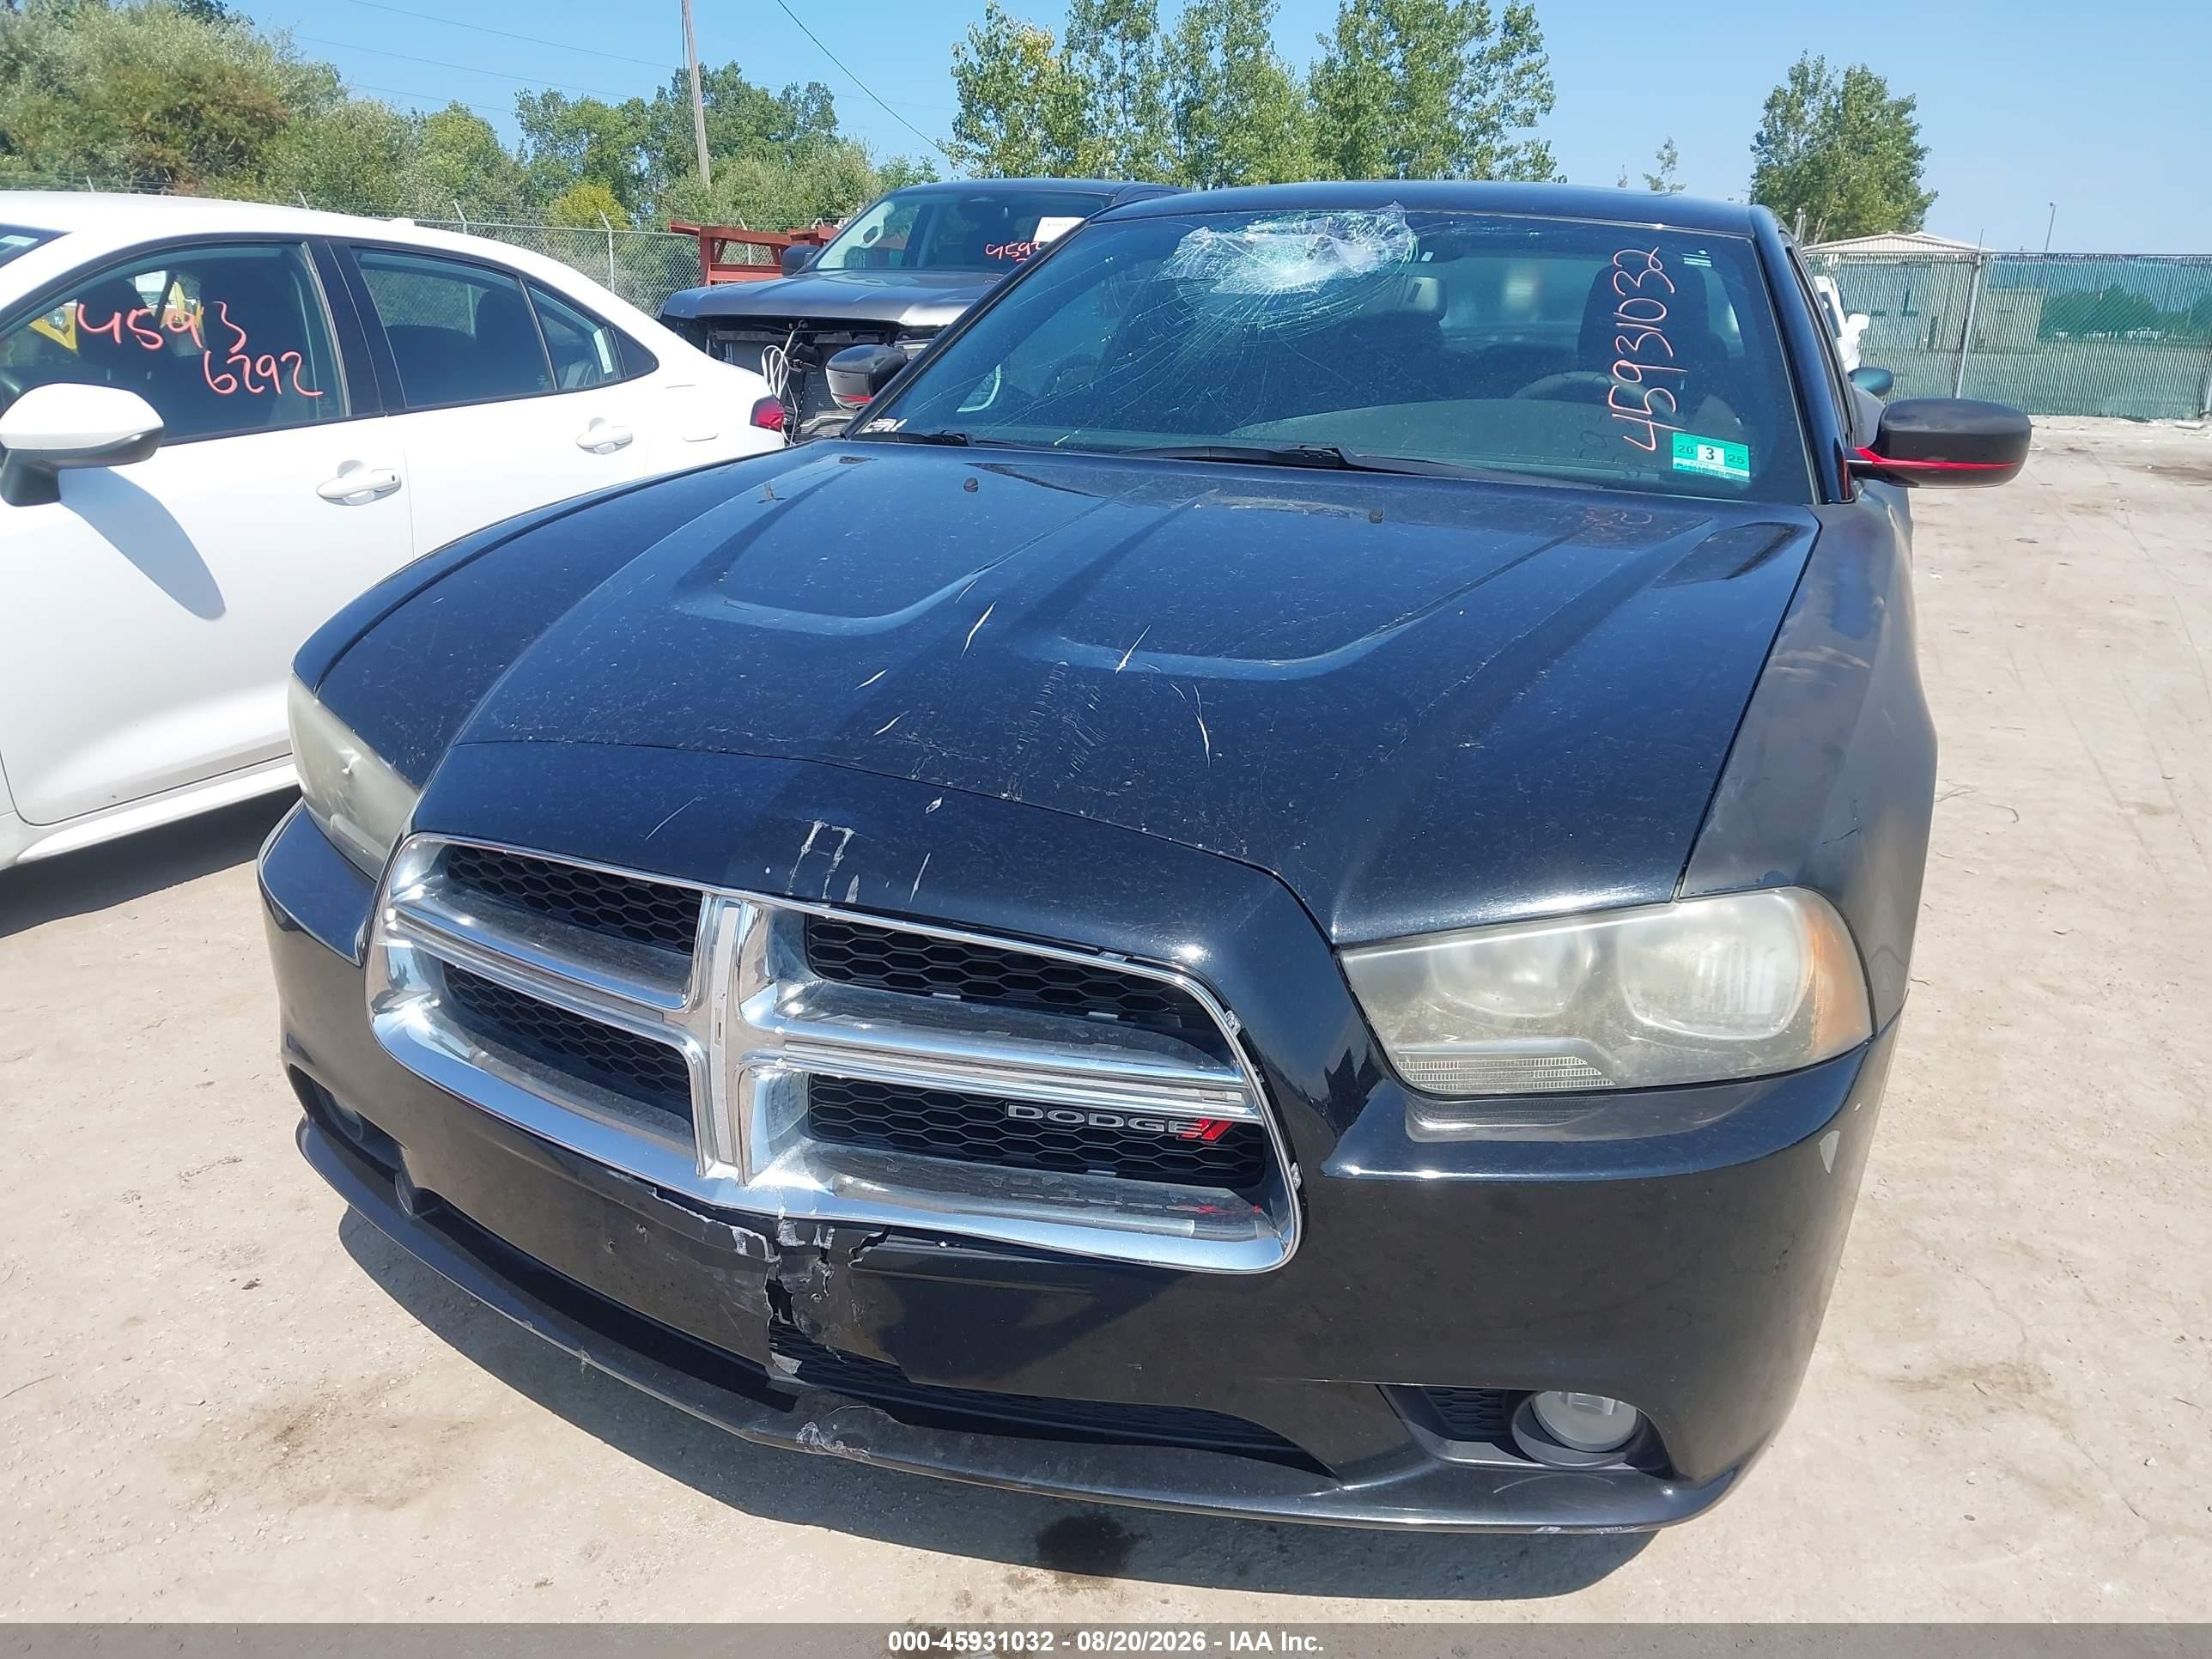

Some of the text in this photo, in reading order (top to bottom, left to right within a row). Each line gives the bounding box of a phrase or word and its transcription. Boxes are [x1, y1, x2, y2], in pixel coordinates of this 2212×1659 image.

[77, 301, 247, 354] 4593
[1607, 246, 1689, 452] 45931032
[1677, 445, 1745, 465] 20 3 25
[1007, 1104, 1205, 1134] DODGE
